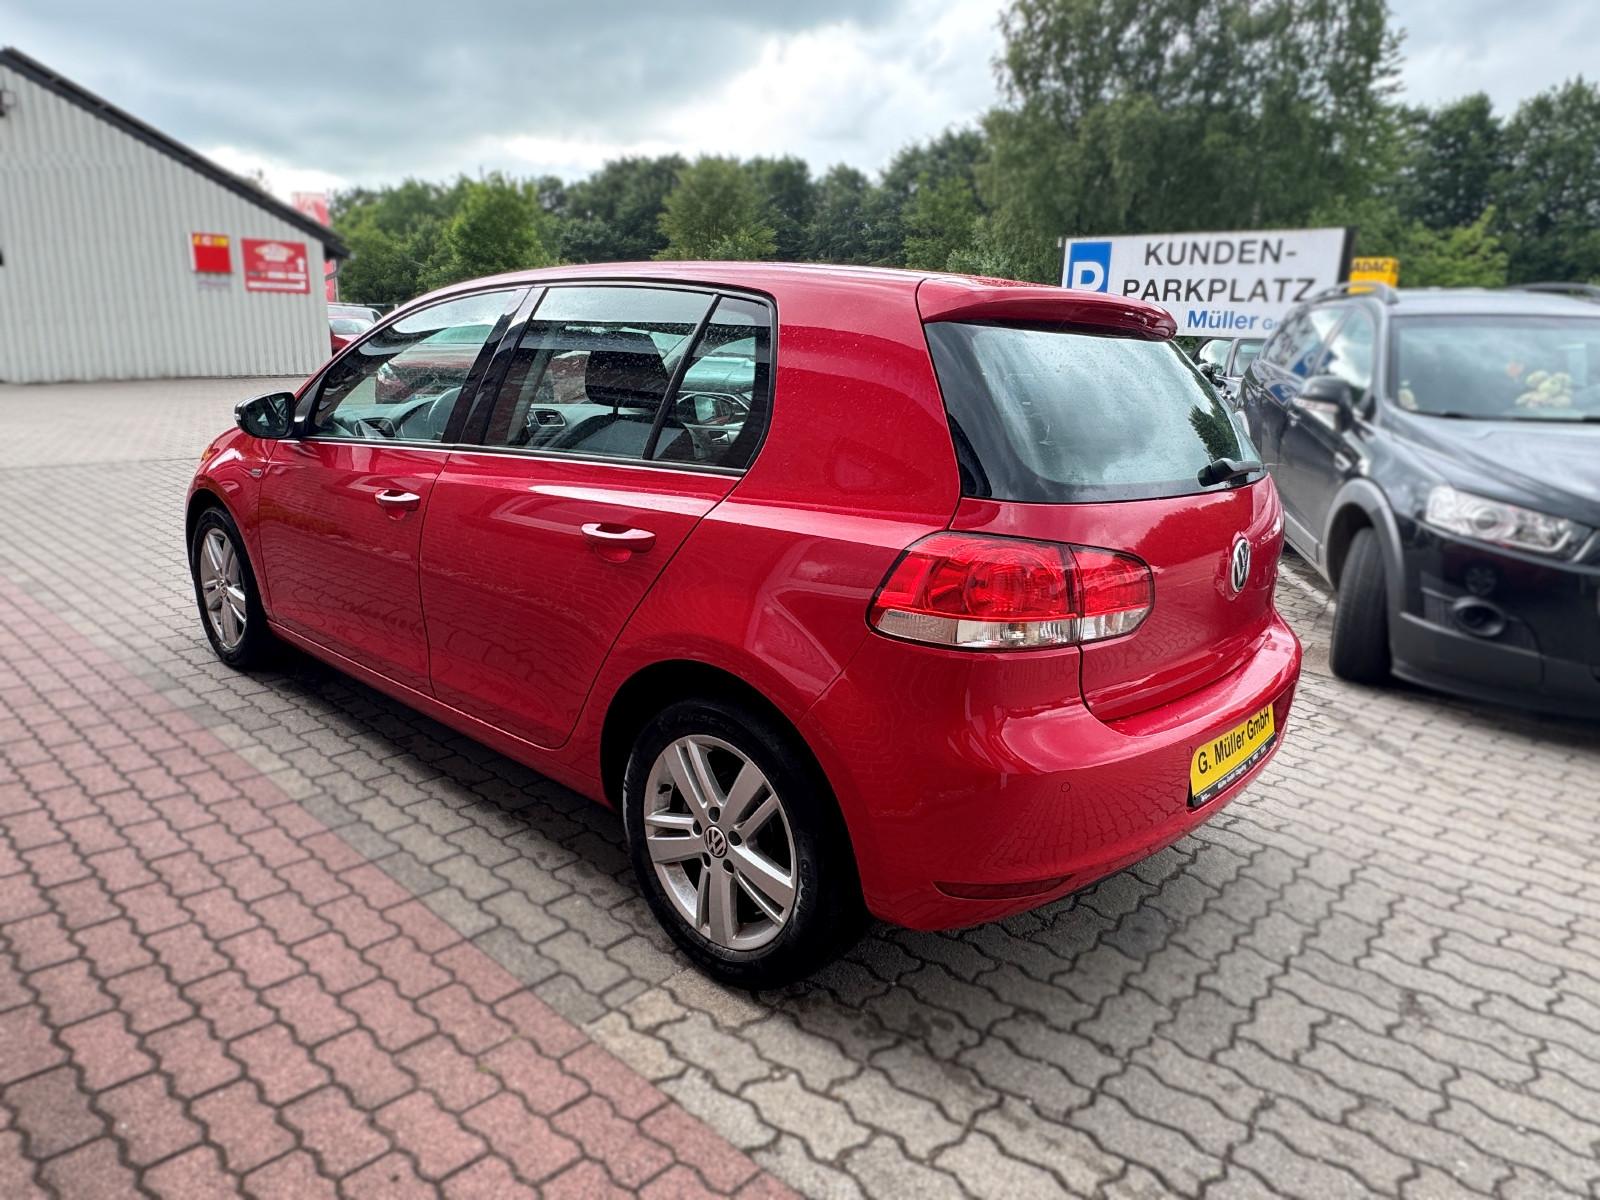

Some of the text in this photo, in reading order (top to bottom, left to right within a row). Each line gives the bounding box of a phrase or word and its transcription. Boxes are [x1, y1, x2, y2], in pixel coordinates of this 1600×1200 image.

[1144, 239, 1297, 266] KUNDEN-
[1072, 261, 1104, 293] P
[1352, 260, 1389, 272] ADAC
[1123, 277, 1316, 302] PARKPLATZ
[1187, 310, 1259, 329] Müller
[1197, 751, 1212, 774] G.
[1214, 729, 1245, 765] Müller
[1247, 705, 1270, 740] GmbH
